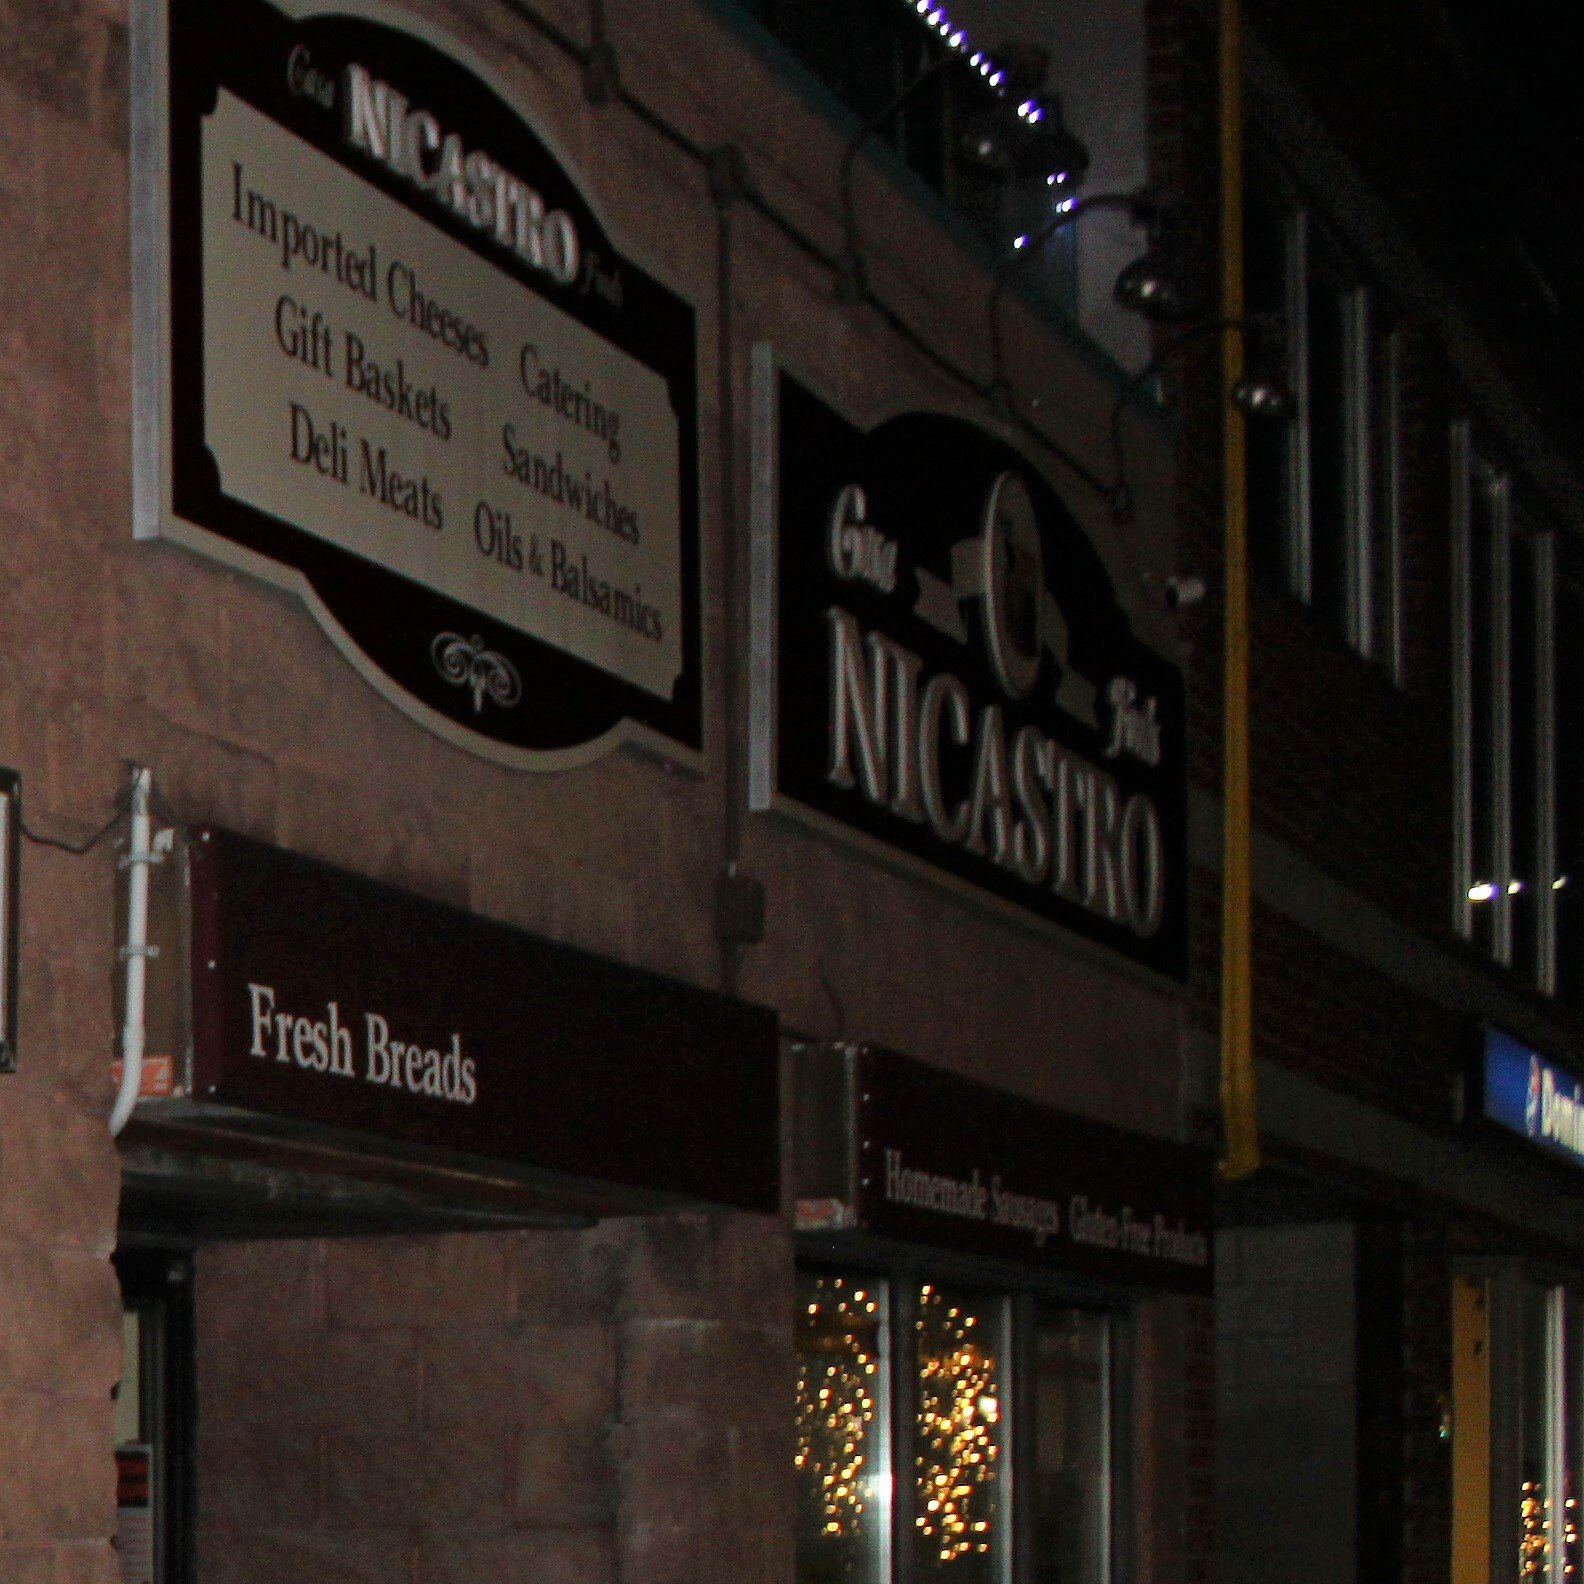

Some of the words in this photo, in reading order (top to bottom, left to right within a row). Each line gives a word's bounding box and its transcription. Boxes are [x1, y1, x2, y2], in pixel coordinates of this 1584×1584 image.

[347, 61, 580, 286] NICASTRO
[232, 161, 379, 303] Imported
[387, 258, 491, 369] Cheeses
[274, 294, 334, 380] Gift
[344, 329, 453, 441] Baskets
[519, 343, 622, 465] Catering
[288, 402, 349, 484] Deli
[359, 437, 444, 530] Meats
[501, 422, 641, 545] Sandwiches
[473, 501, 524, 573] Oils
[550, 540, 664, 643] Balsamics
[828, 605, 1165, 938] NICASTRO
[247, 981, 355, 1078] Fresh
[365, 1012, 477, 1105] Breads
[884, 1146, 989, 1221] Homemade
